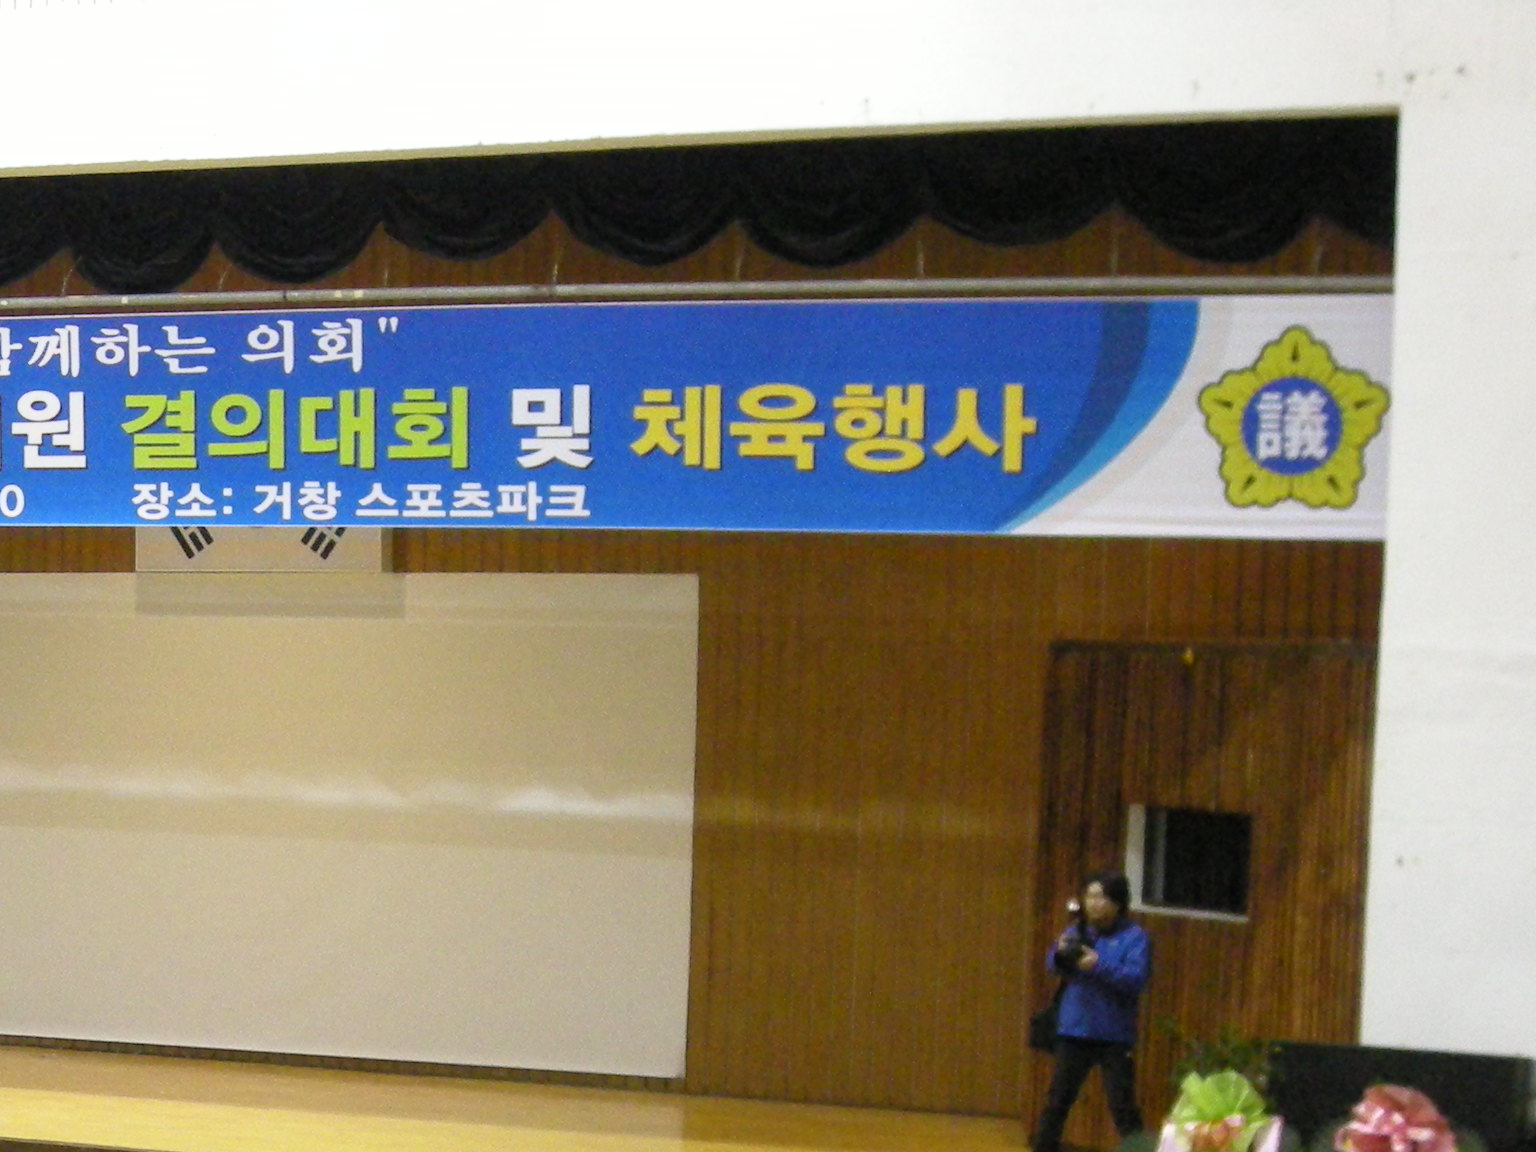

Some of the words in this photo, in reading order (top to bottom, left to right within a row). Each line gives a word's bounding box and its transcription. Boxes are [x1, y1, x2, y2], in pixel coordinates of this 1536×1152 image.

[240, 315, 401, 374] 의회"
[120, 386, 469, 470] 결의대회
[510, 383, 595, 470] 및
[629, 383, 1038, 474] 체육행사
[1256, 389, 1330, 464] 議
[130, 481, 234, 521] 장소:
[252, 480, 342, 521] 거창
[354, 480, 592, 522] 스포츠파크
